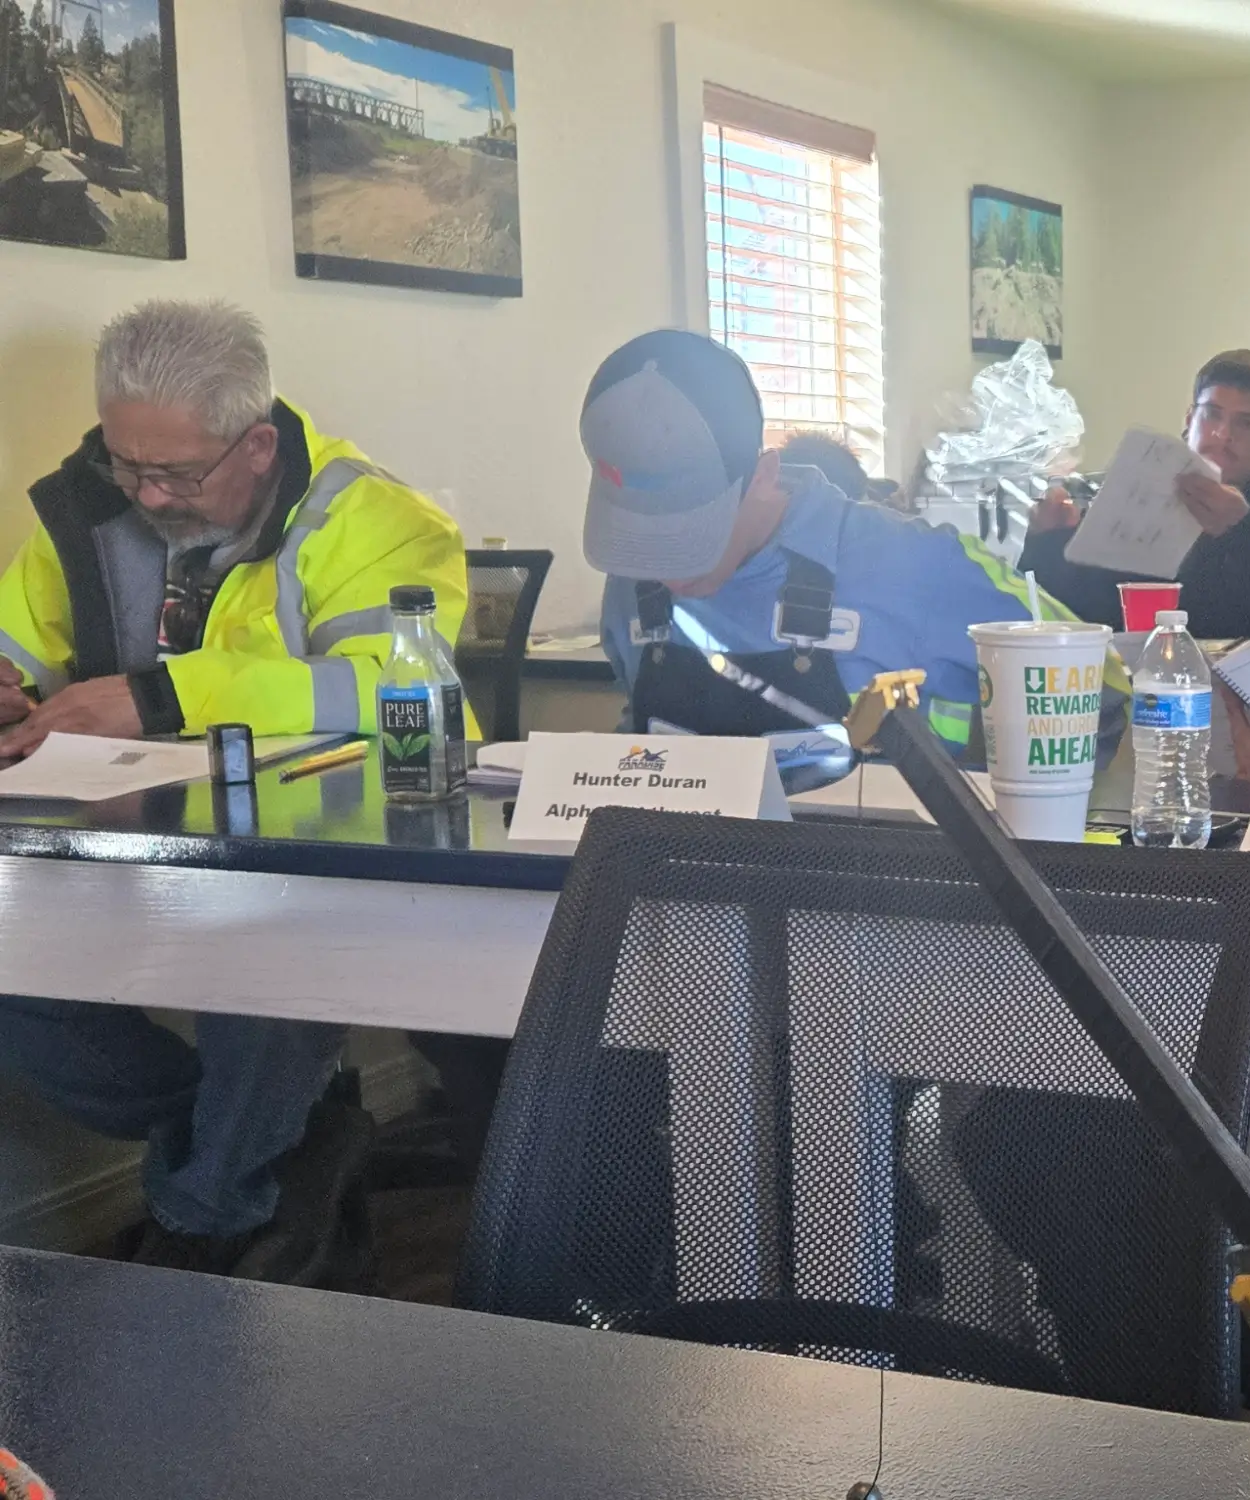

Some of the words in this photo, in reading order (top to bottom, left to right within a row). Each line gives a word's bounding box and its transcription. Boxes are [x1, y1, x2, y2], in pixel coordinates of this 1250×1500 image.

[385, 702, 424, 715] PURE
[385, 715, 424, 728] LEAF
[1027, 717, 1063, 737] AND
[573, 771, 642, 787] Hunter
[647, 774, 707, 789] Duran
[544, 803, 592, 821] Alph
